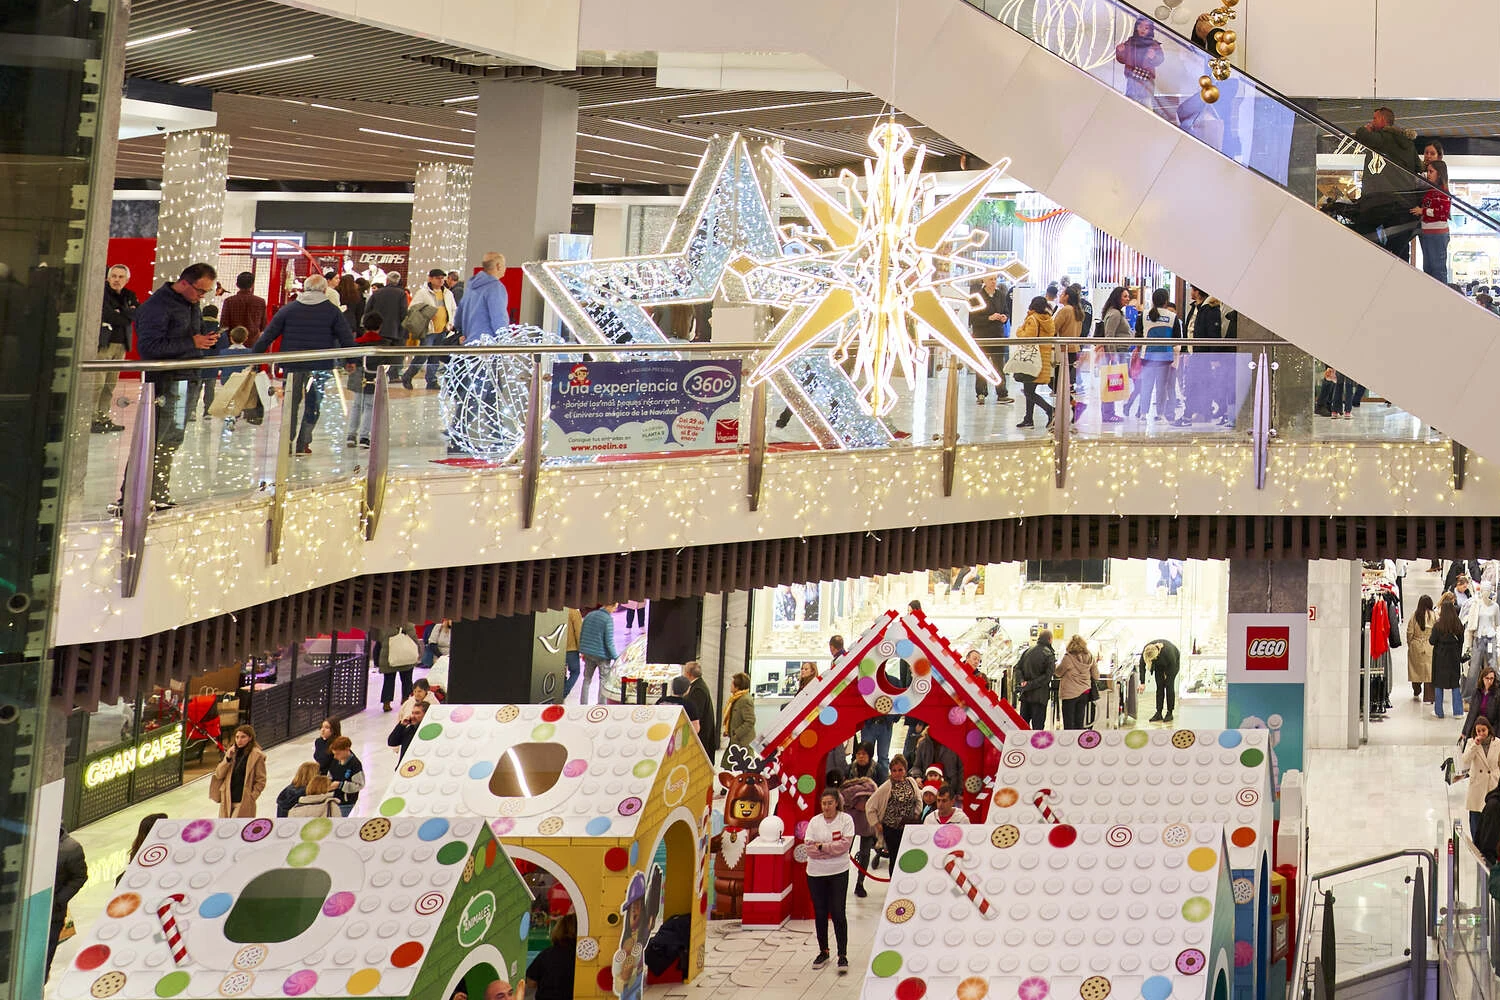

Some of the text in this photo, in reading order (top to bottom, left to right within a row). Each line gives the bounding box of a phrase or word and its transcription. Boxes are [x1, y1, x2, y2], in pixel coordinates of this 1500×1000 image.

[559, 381, 590, 395] Una
[593, 379, 678, 397] experiencia
[571, 441, 628, 451] www.noelin.es
[1249, 639, 1287, 657] LEGO
[85, 724, 183, 787] GRAN CAFÉ
